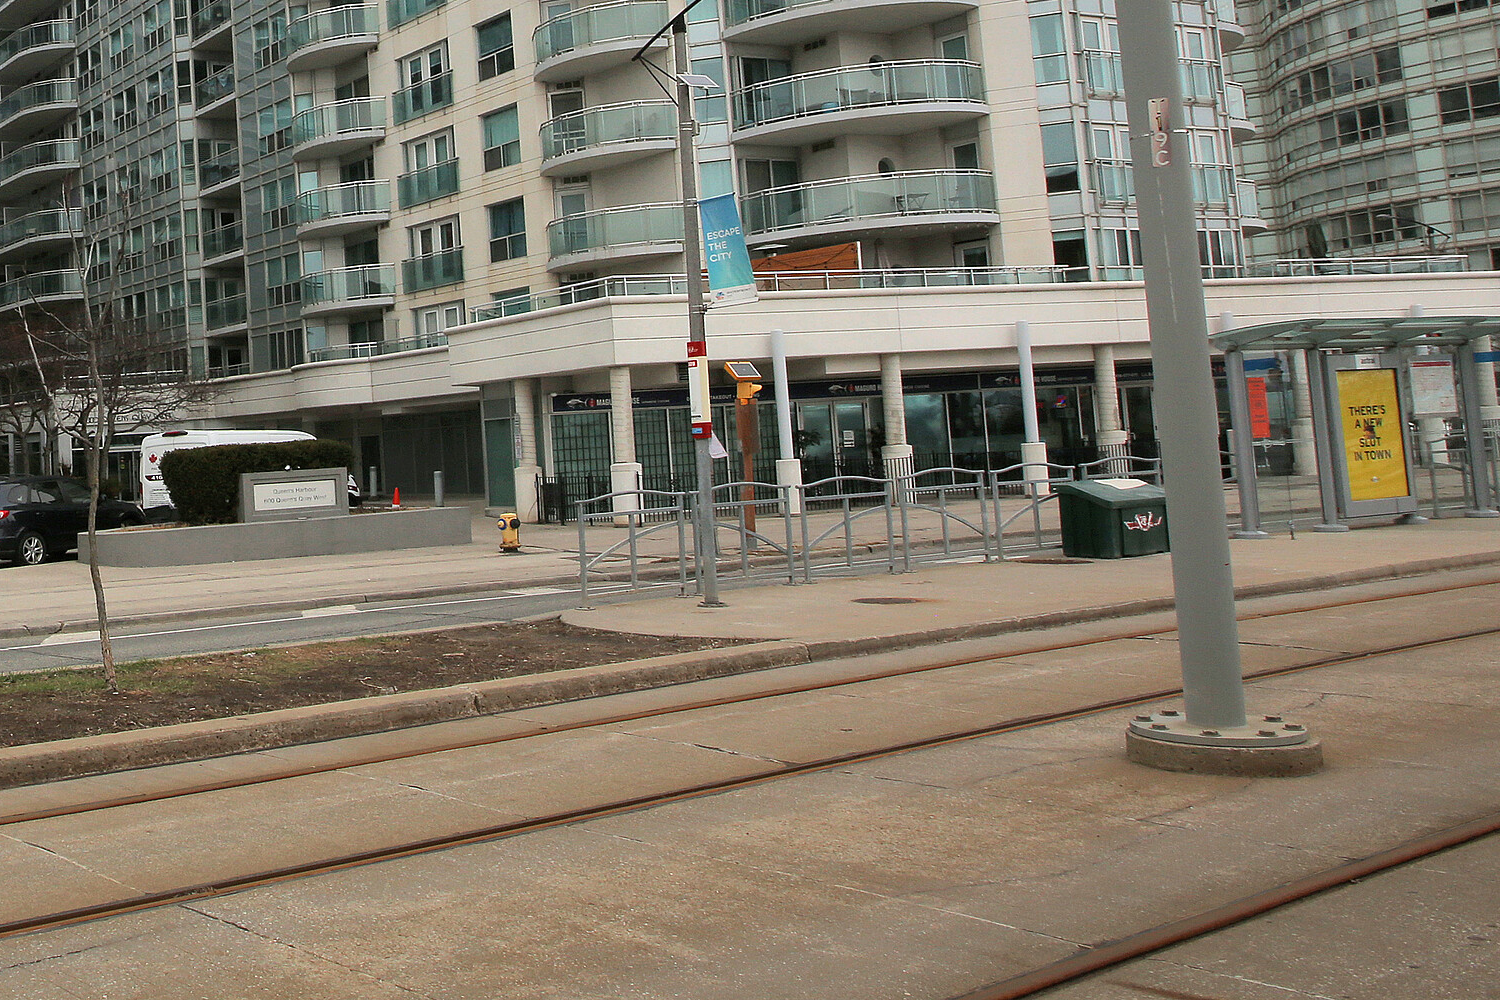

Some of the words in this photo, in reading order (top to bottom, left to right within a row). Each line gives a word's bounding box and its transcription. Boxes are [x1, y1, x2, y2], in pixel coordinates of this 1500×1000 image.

[706, 226, 740, 240] ESCAPE
[708, 241, 727, 251] THE
[709, 251, 732, 263] CITY
[1348, 404, 1386, 416] THERE'S
[1355, 418, 1361, 429] A
[1363, 418, 1383, 428] NEW
[1354, 451, 1363, 461] IN
[1364, 449, 1392, 460] TOWN
